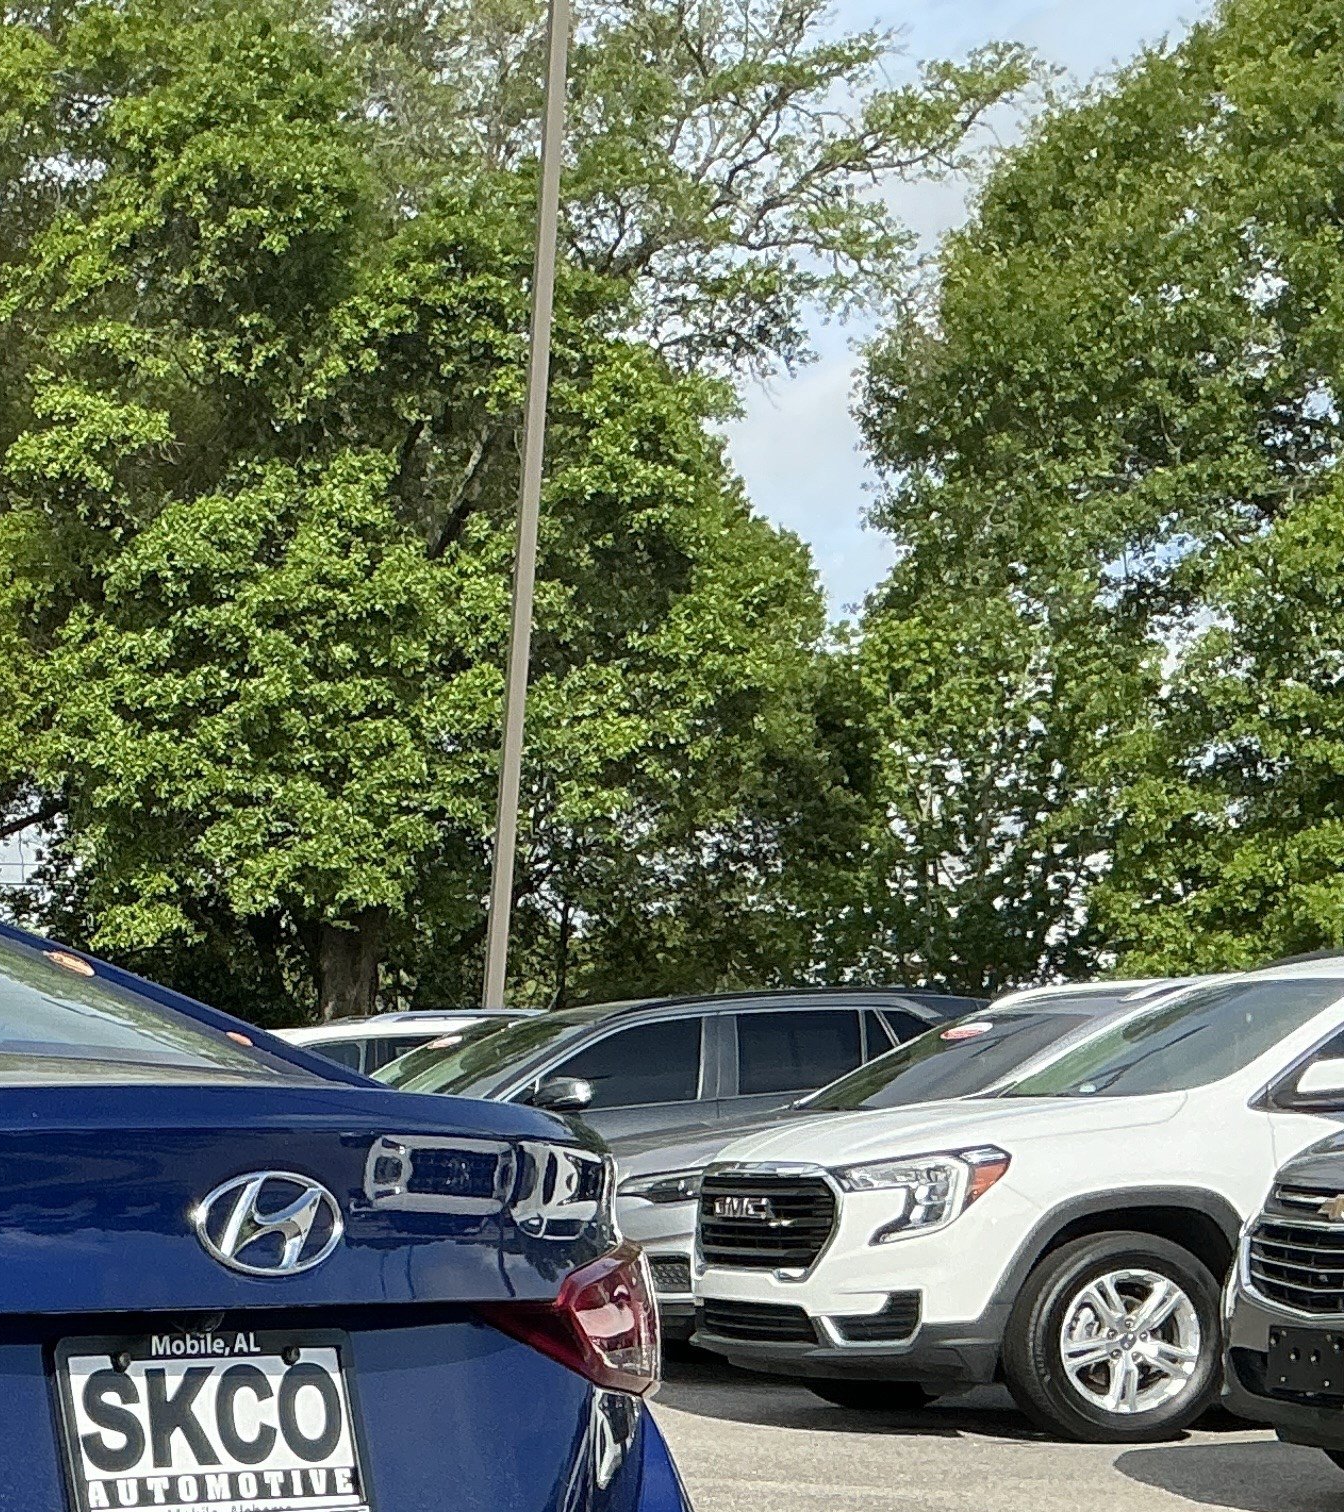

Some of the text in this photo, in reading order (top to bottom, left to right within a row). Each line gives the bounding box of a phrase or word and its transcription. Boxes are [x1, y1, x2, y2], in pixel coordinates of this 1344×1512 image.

[714, 1197, 769, 1219] GMC
[150, 1331, 262, 1356] Mobile, AL
[80, 1361, 343, 1473] SKCO
[87, 1467, 355, 1509] AUTOMOTIVE
